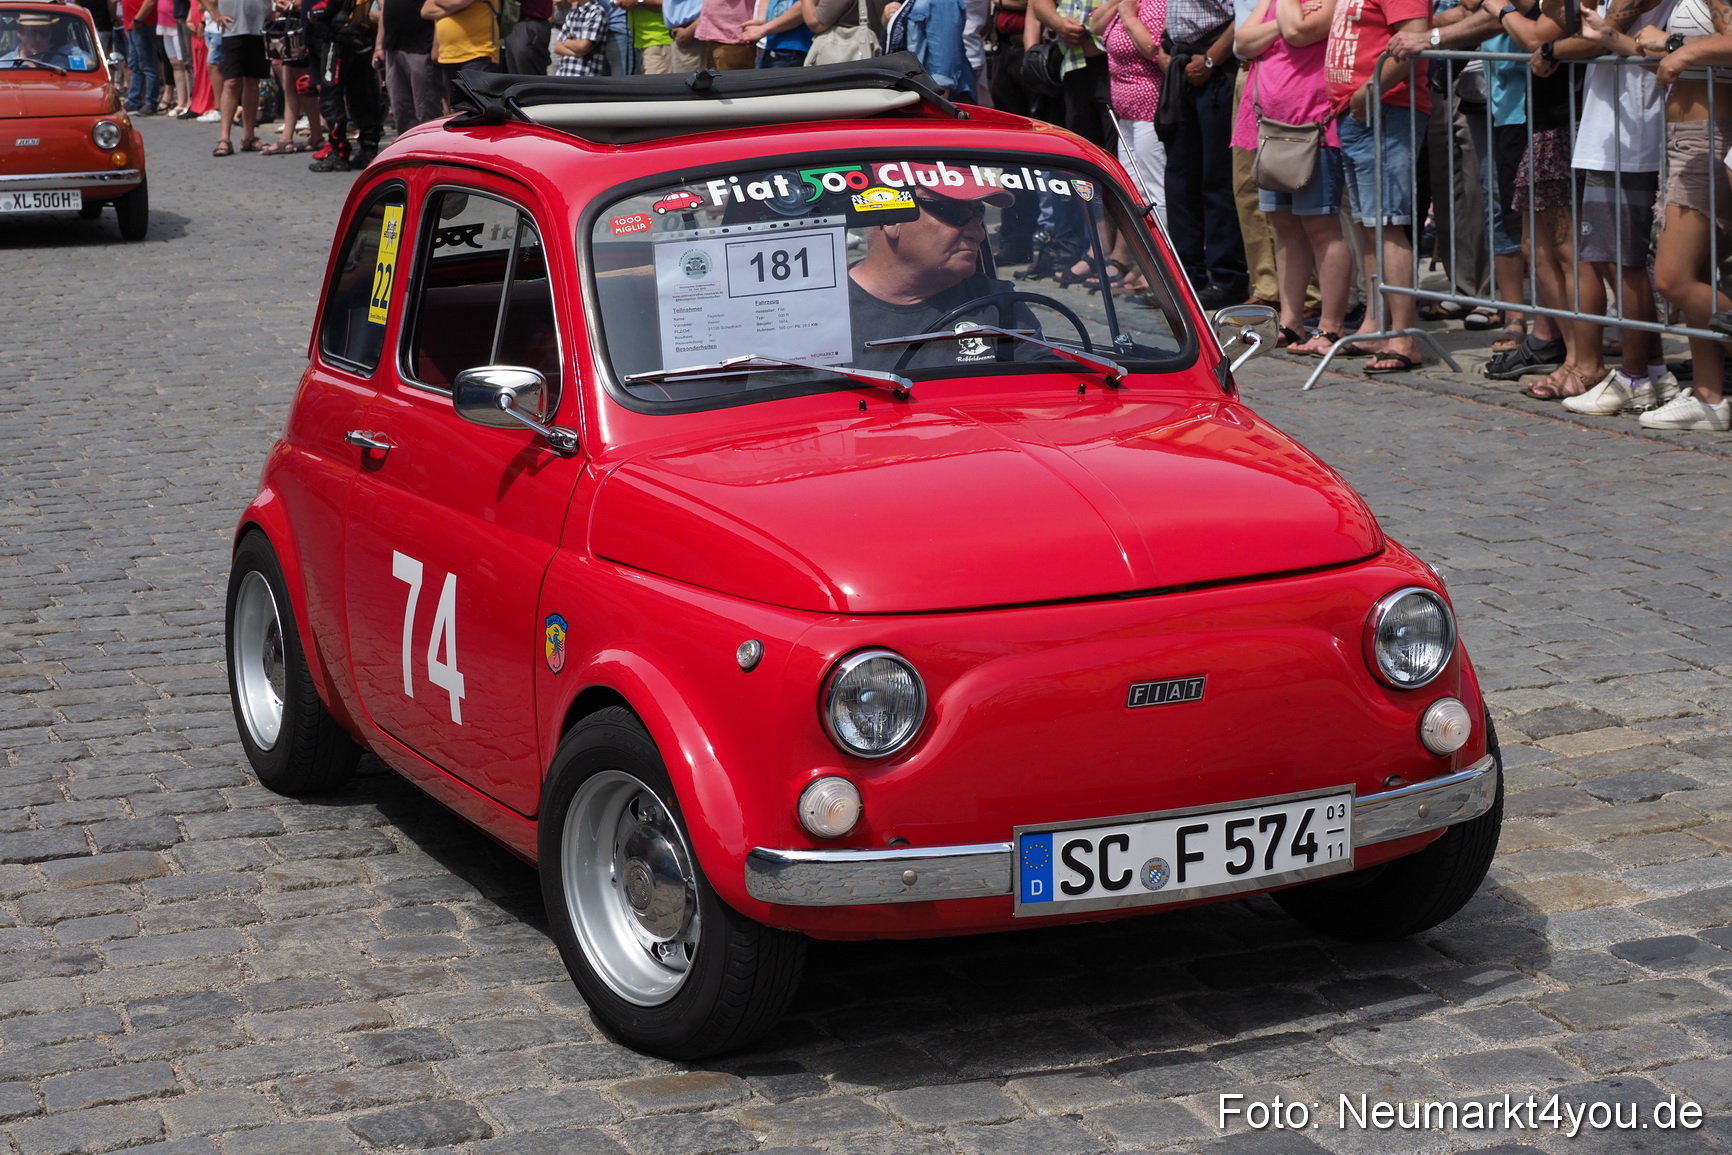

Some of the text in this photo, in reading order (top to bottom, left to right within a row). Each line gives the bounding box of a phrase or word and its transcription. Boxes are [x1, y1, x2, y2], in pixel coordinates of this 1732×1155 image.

[706, 161, 1072, 207] Fiat 500 Club Italia
[13, 193, 32, 209] XL
[615, 215, 642, 226] 1000
[615, 223, 647, 234] MIGLIA
[750, 247, 809, 282] 181
[372, 262, 392, 309] 22
[676, 344, 717, 352] Besonderheiten
[392, 549, 466, 726] 74
[1133, 681, 1200, 704] FIAT
[1327, 803, 1346, 820] 03
[1031, 879, 1043, 896] D
[1060, 833, 1133, 896] SC
[1177, 823, 1209, 883] F
[1225, 807, 1318, 875] 574
[1327, 842, 1344, 859] 11
